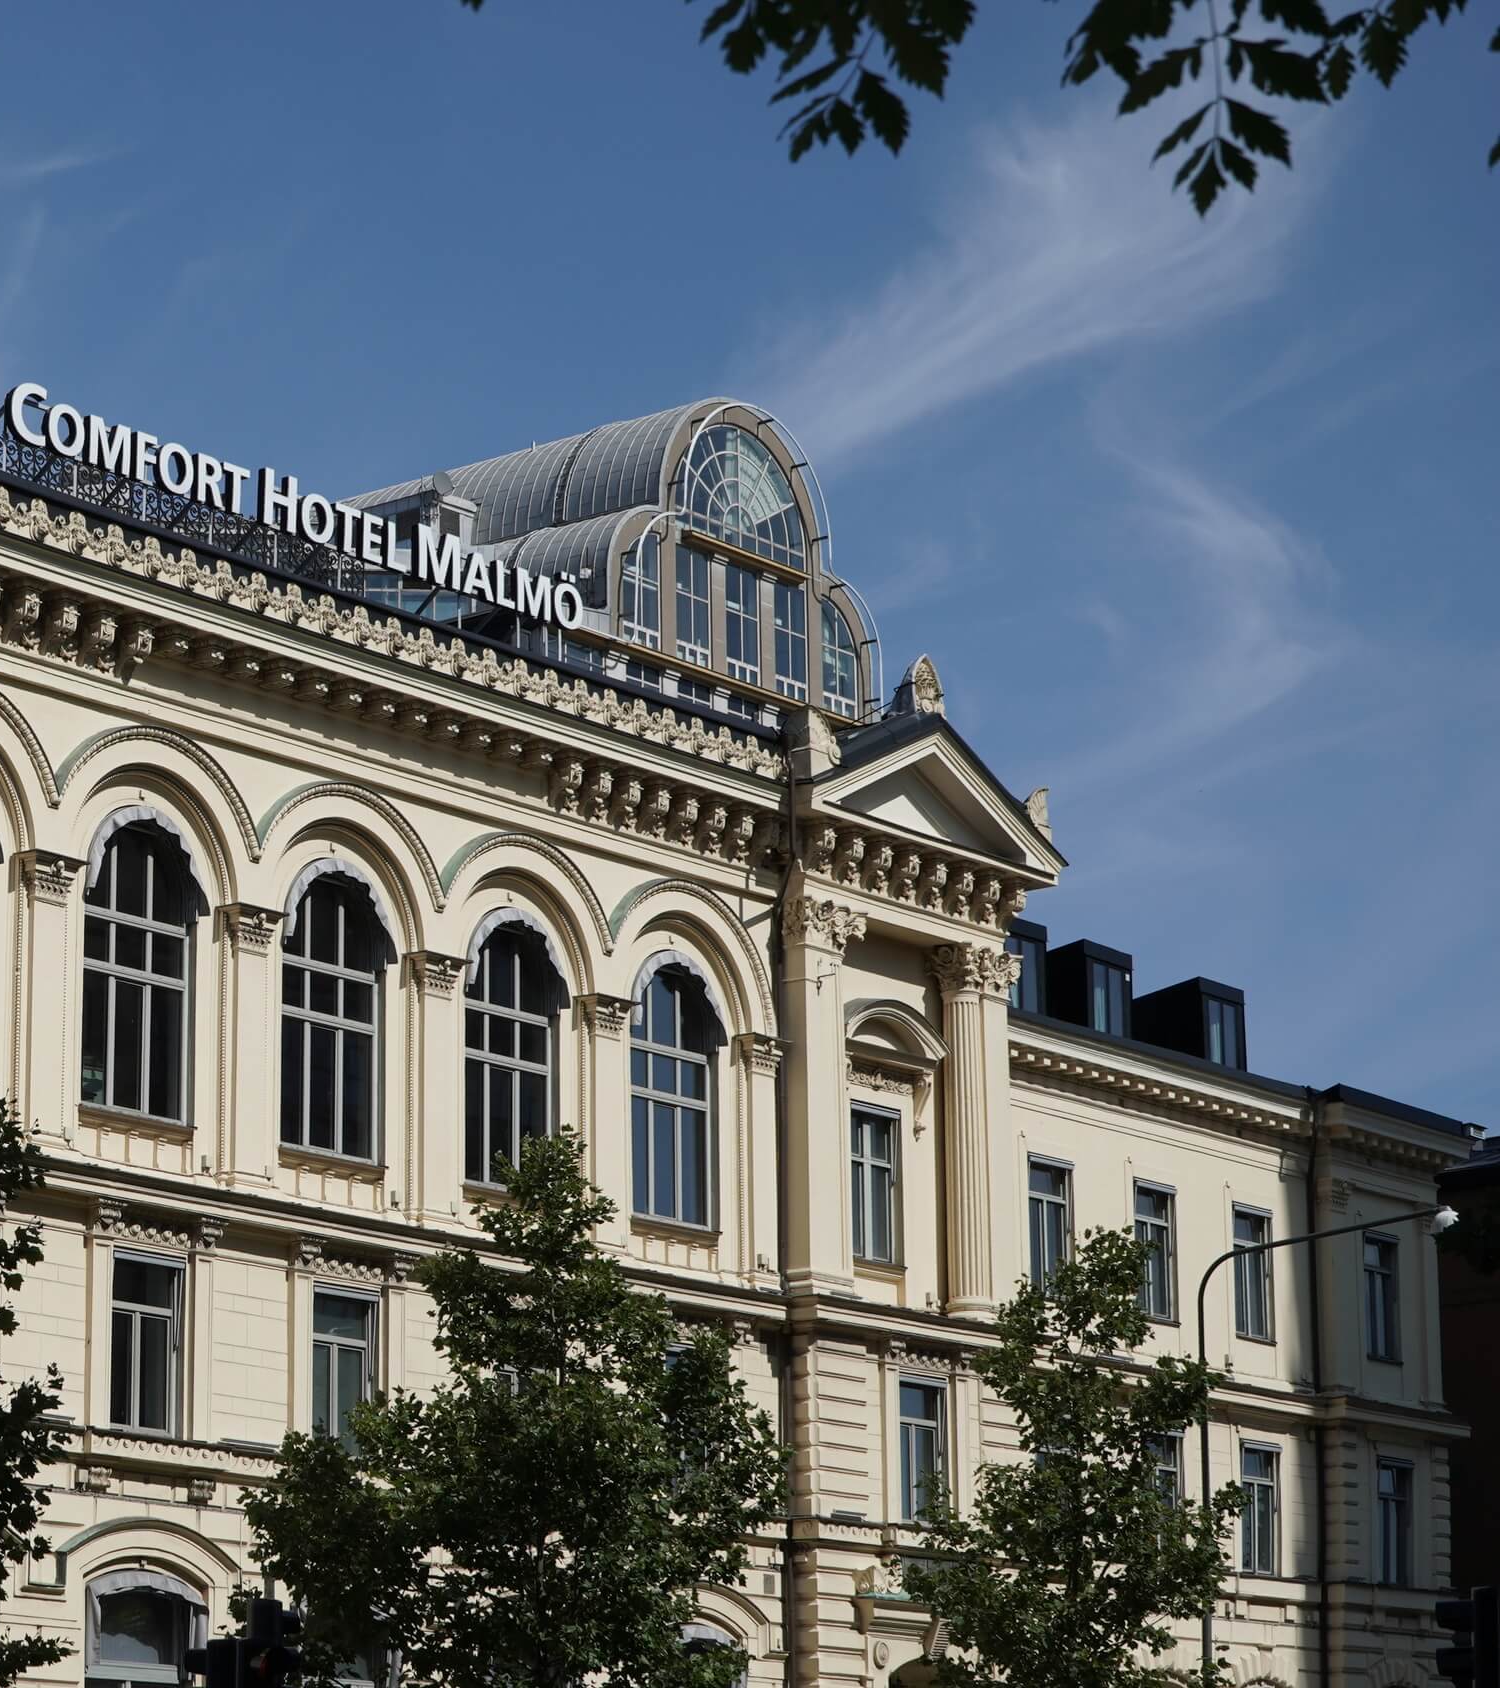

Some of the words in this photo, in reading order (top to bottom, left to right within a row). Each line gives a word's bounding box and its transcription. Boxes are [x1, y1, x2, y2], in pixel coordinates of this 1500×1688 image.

[8, 383, 250, 514] COMFORT
[260, 467, 409, 573] HOTEL
[416, 525, 583, 629] MALMÖ
